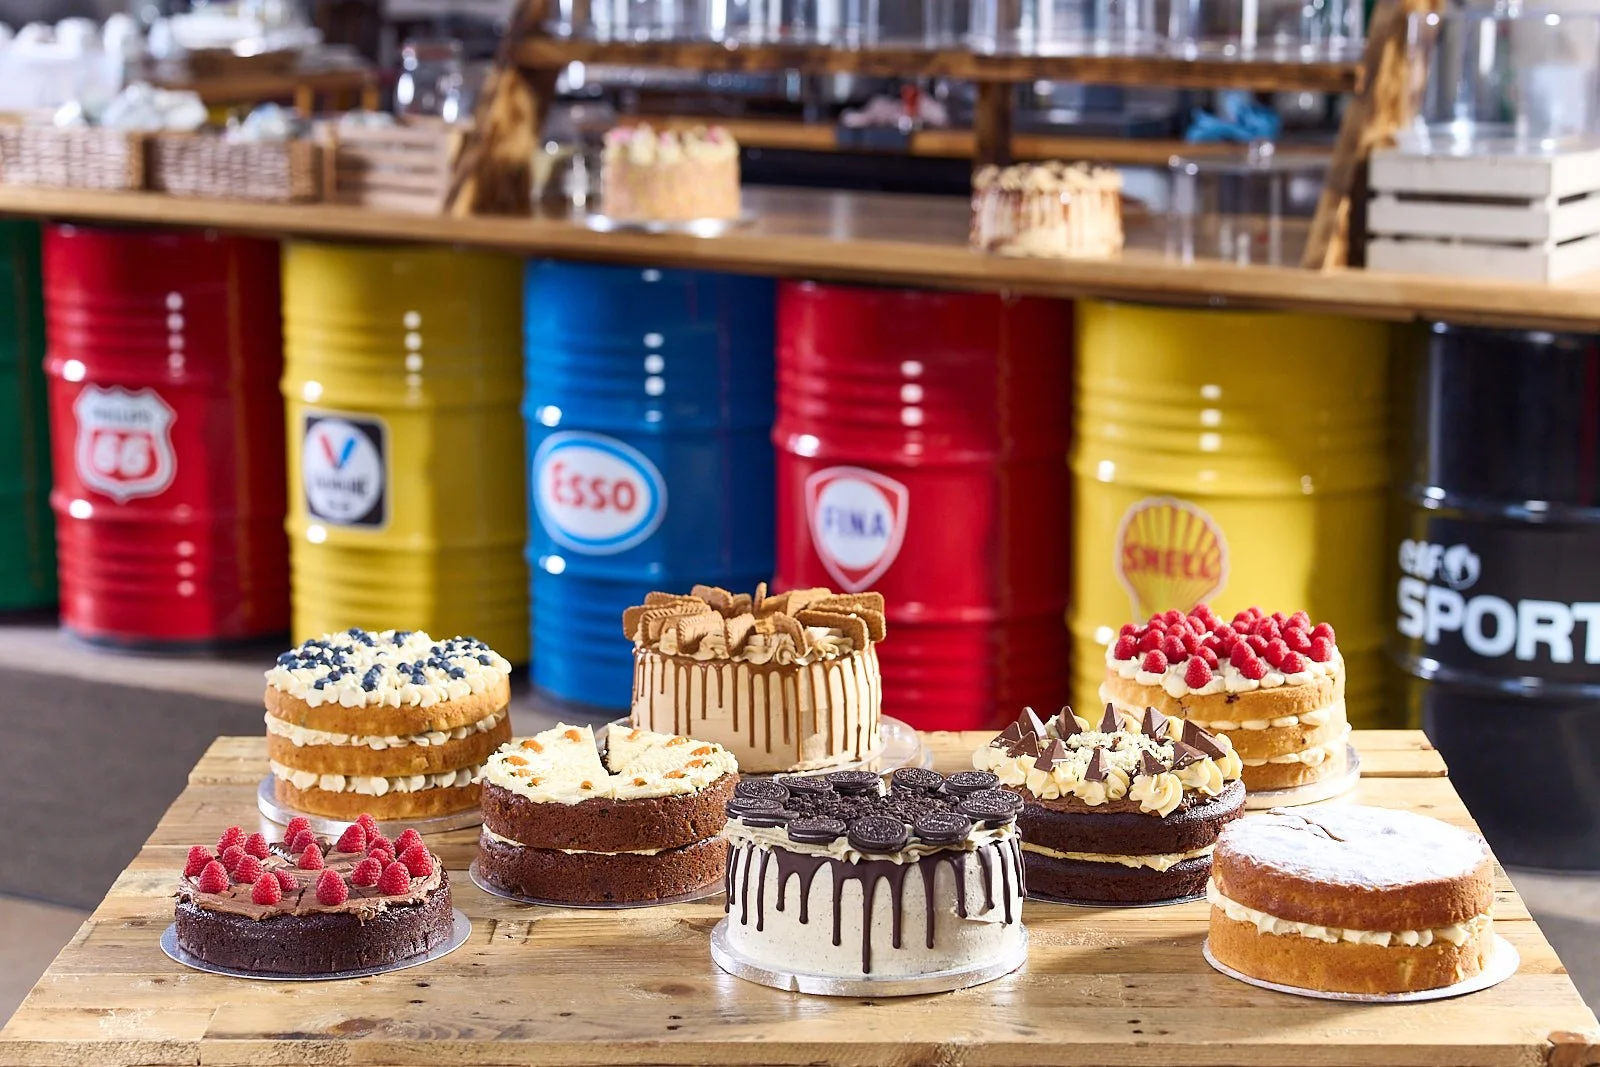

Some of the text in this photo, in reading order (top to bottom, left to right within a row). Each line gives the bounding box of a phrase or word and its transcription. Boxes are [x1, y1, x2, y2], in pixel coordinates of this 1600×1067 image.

[92, 434, 152, 476] 66
[552, 460, 637, 514] Esso
[824, 504, 887, 538] FINA
[1122, 543, 1219, 580] SHELL
[1397, 576, 1600, 664] SPORT
